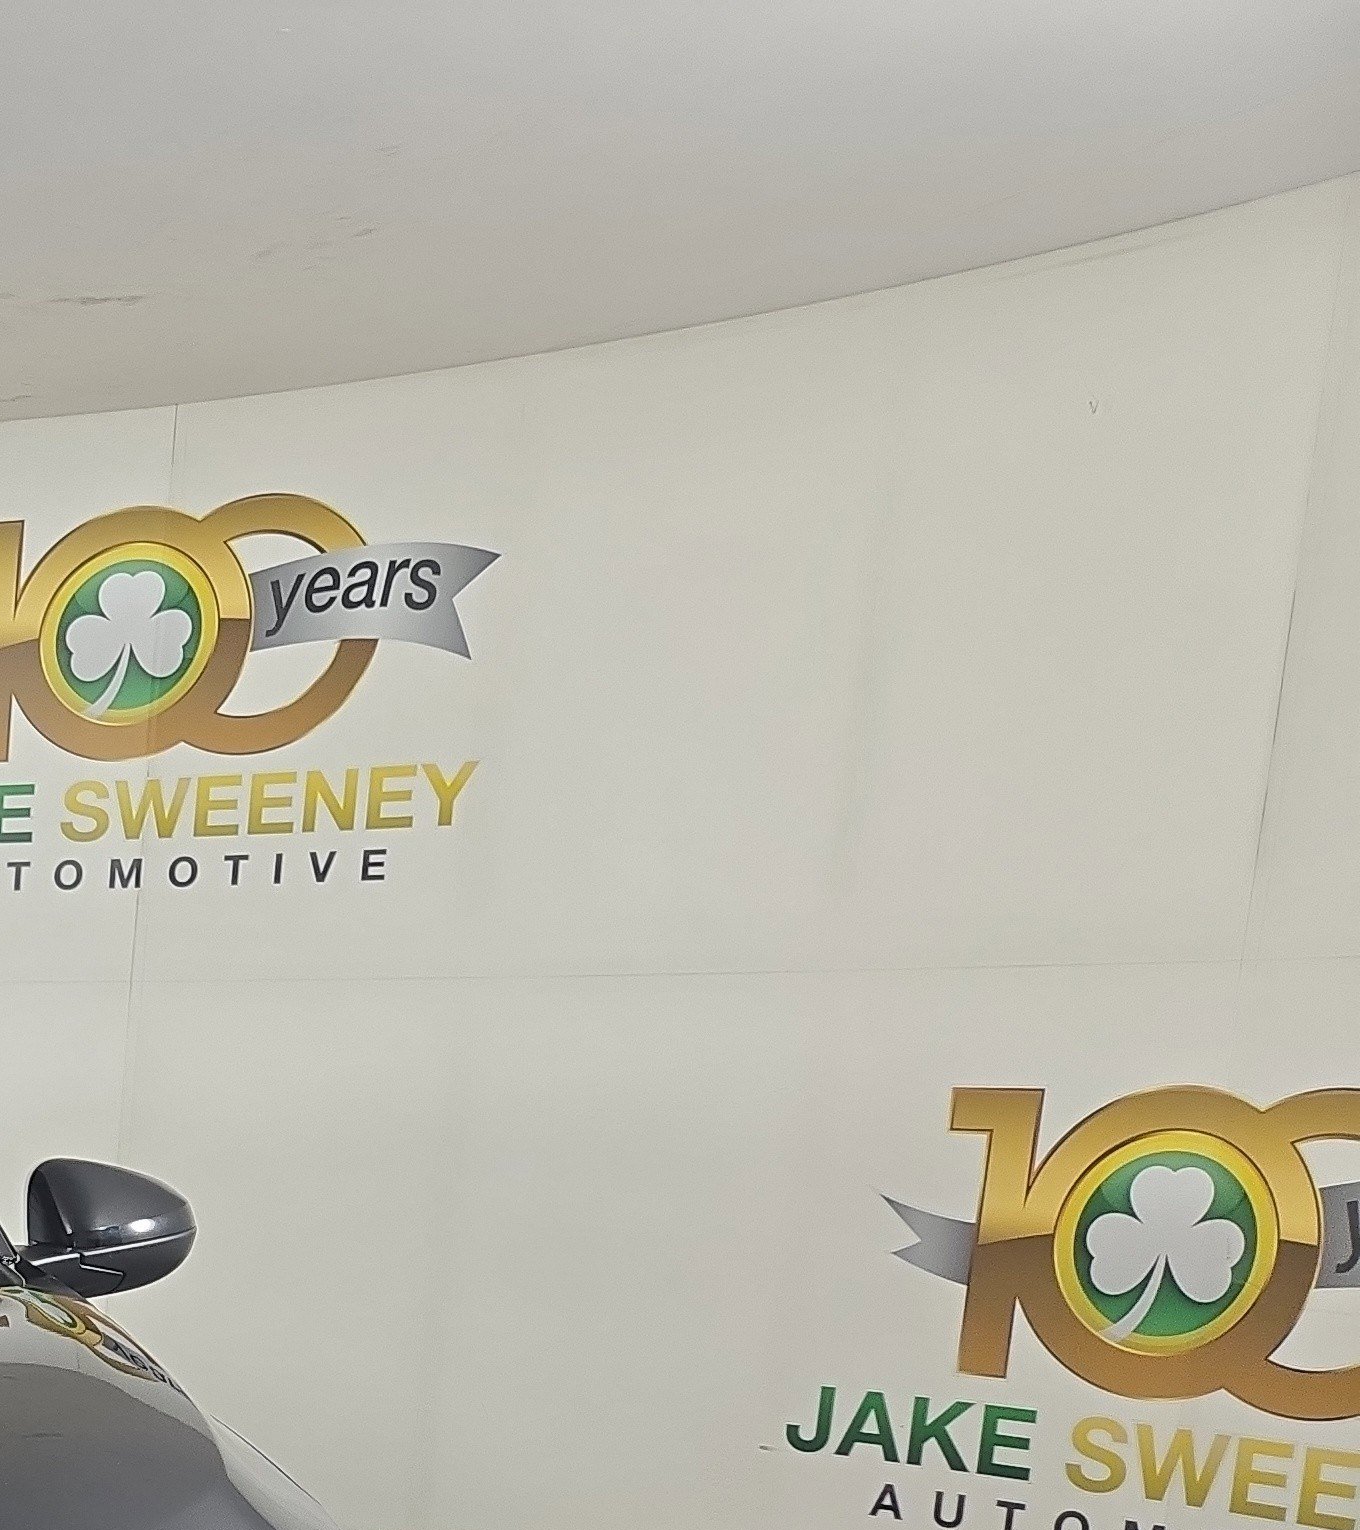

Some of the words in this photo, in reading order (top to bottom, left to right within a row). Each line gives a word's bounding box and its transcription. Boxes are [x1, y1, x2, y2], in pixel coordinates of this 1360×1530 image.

[265, 557, 441, 638] years
[60, 760, 479, 844] SWEENEY
[786, 1385, 1038, 1480] JAKE
